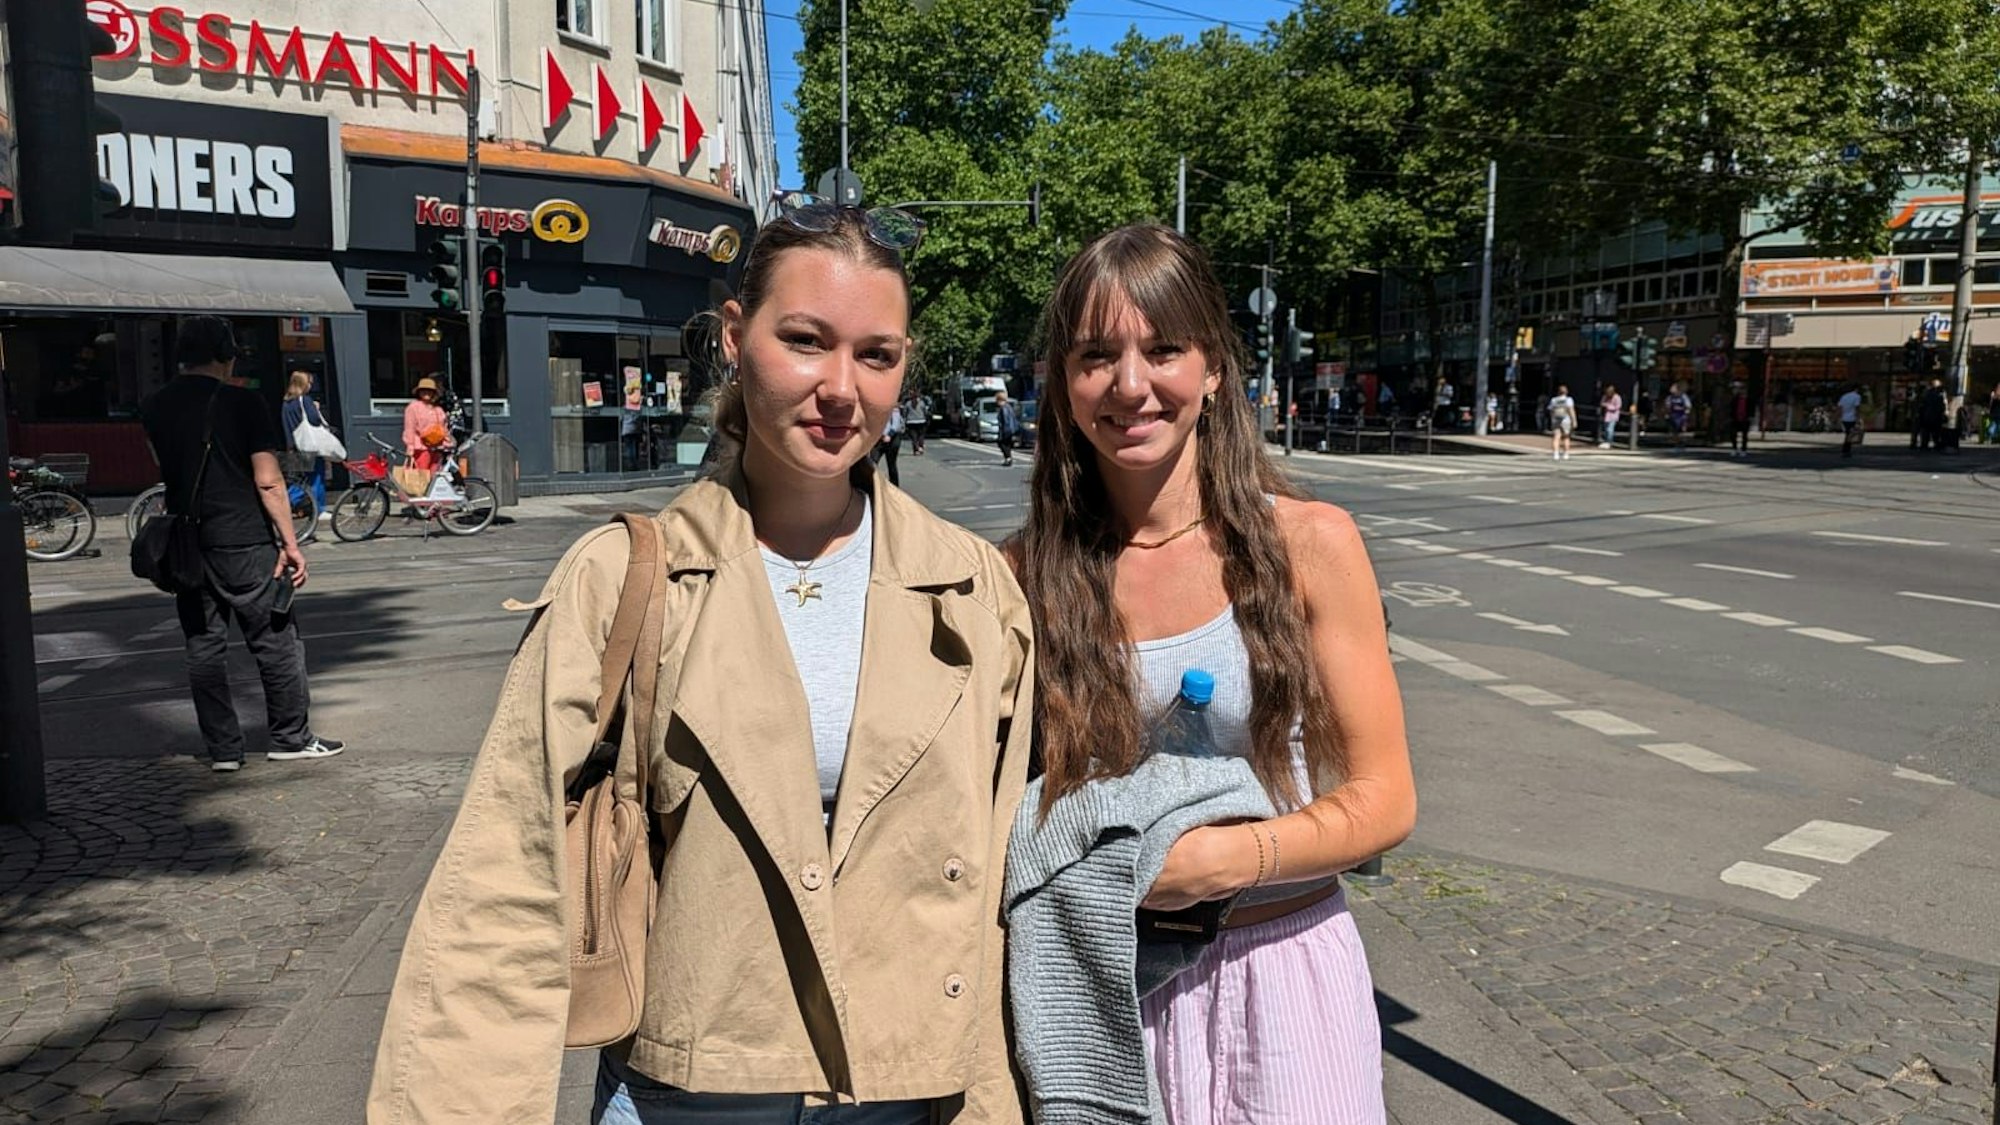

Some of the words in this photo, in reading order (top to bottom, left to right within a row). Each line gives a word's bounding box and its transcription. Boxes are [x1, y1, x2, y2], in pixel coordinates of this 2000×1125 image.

[86, 0, 474, 95] OSSMANN
[415, 195, 530, 236] Kamps
[1888, 197, 1964, 229] Jus
[650, 217, 712, 256] Kamps
[1767, 271, 1820, 288] START
